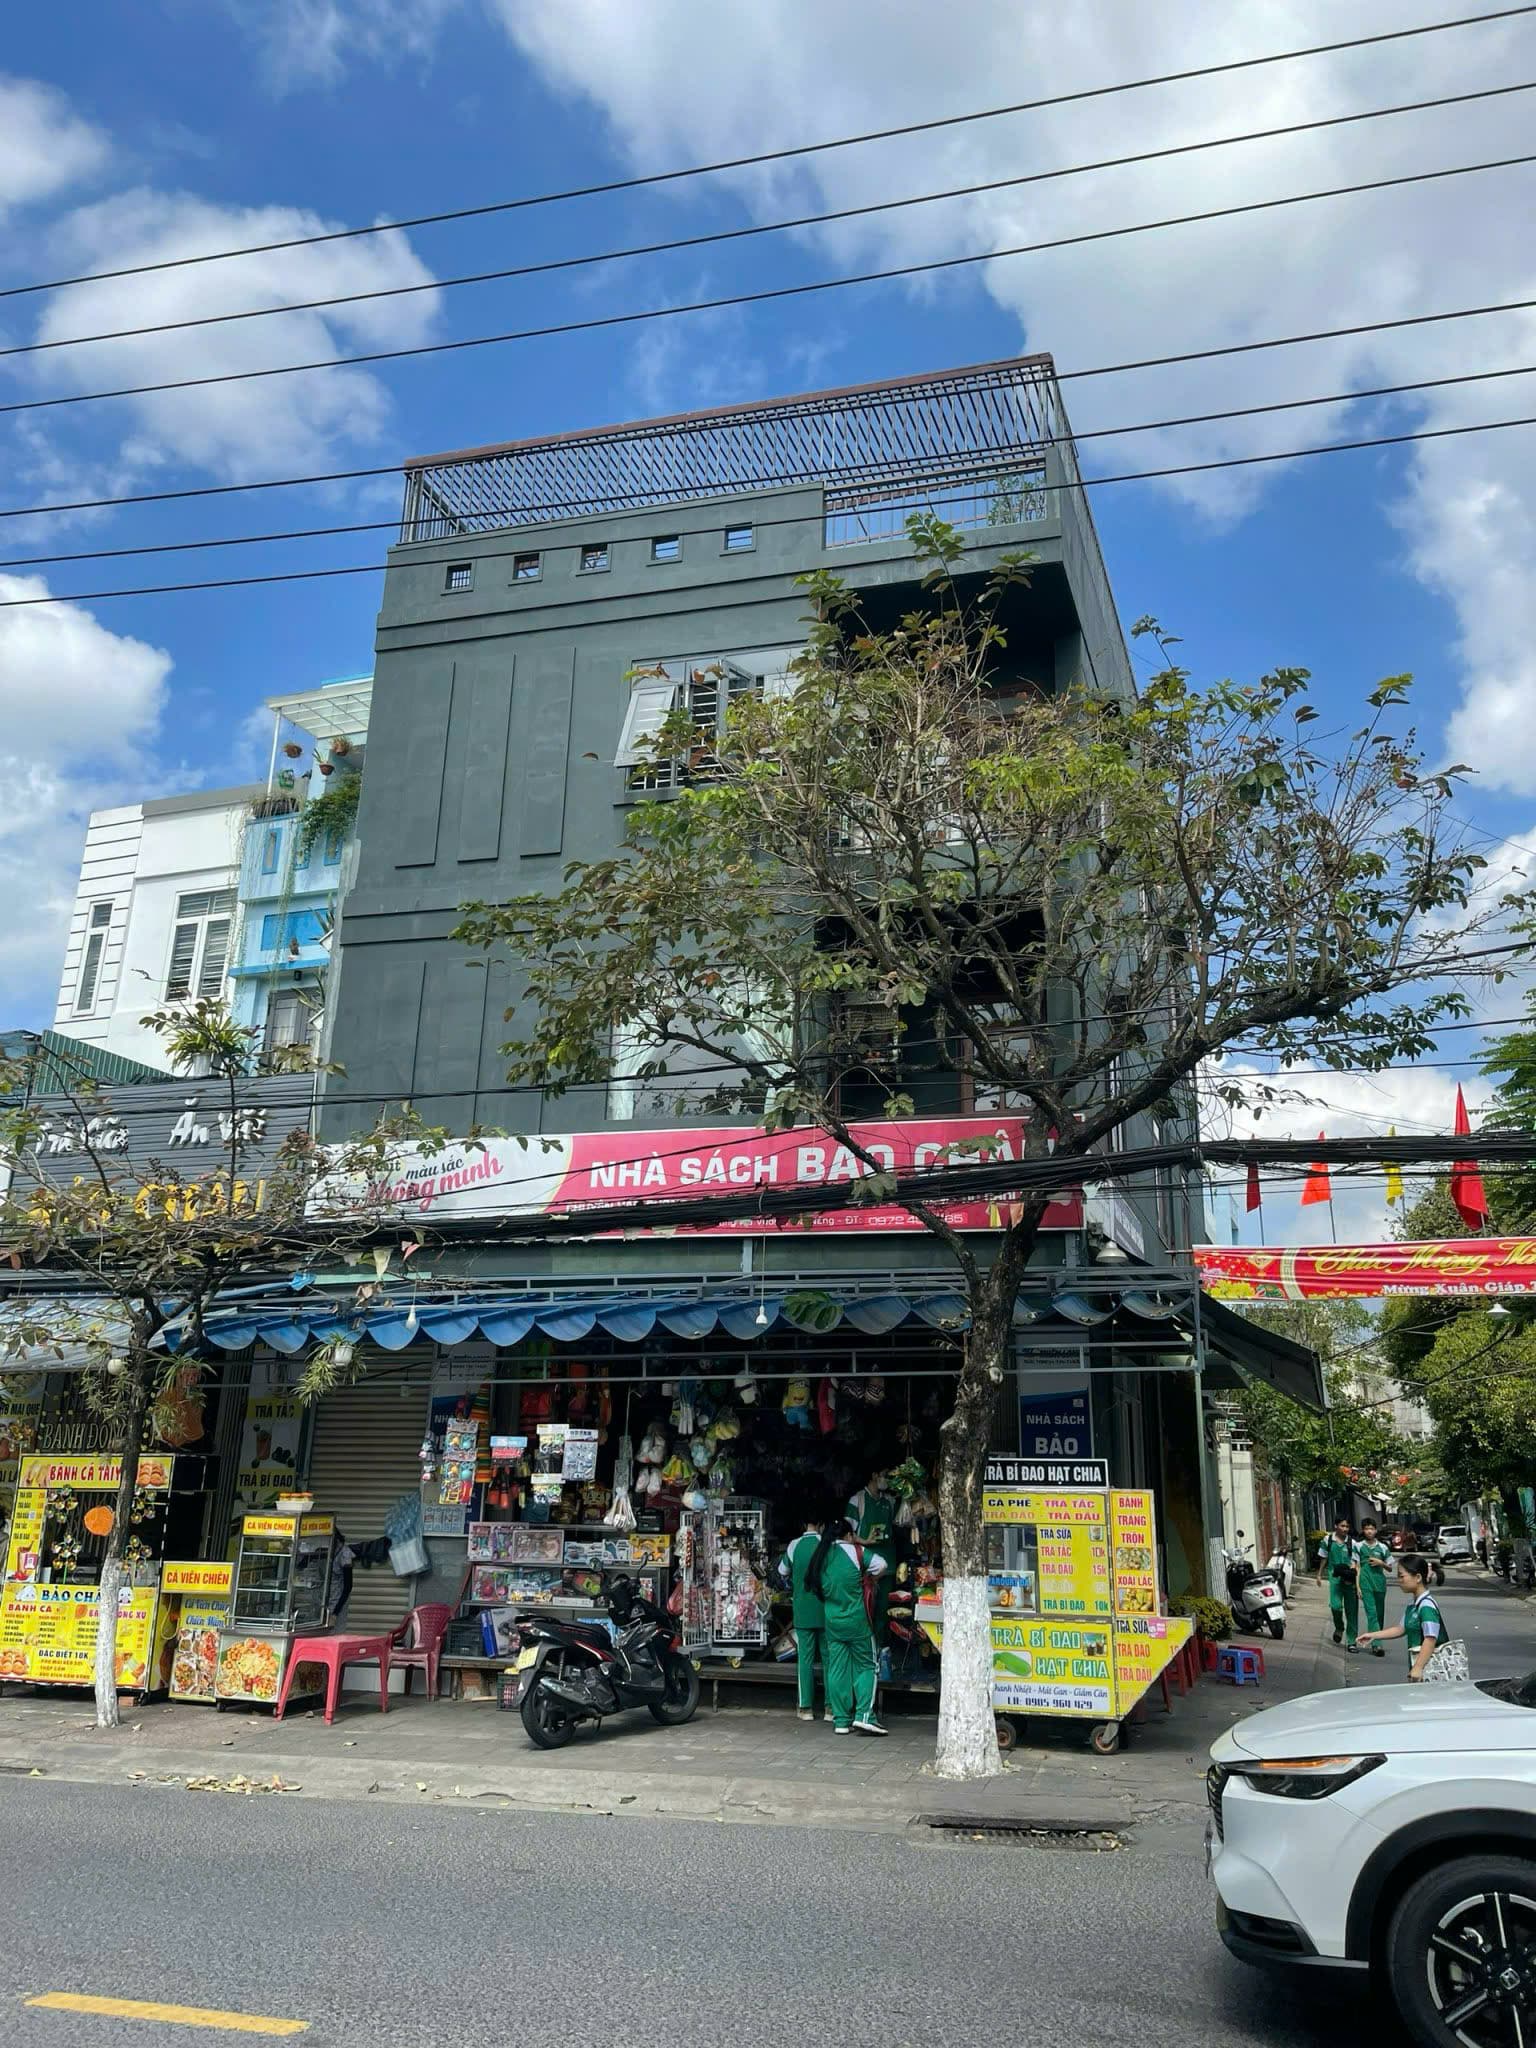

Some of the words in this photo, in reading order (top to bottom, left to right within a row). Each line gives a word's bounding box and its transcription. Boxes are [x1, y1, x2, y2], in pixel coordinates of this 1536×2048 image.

[406, 1163, 439, 1180] màu
[441, 1154, 465, 1173] sắc
[439, 1150, 504, 1195] minh
[590, 1151, 667, 1188] NHÀ
[679, 1149, 779, 1184] SÁCH
[1383, 1284, 1430, 1297] Mừng
[1435, 1282, 1481, 1295] Xuân
[1484, 1281, 1526, 1295] Giáp
[1026, 1412, 1051, 1425] NHÀ
[1054, 1412, 1085, 1425] SÁCH
[1035, 1432, 1079, 1455] BẢO
[50, 1462, 78, 1481] BÁNH
[81, 1462, 94, 1481] CÁ
[239, 1471, 257, 1487] TRÀ
[259, 1471, 270, 1487] BÍ
[1006, 1462, 1018, 1481] BÍ
[1021, 1465, 1045, 1481] ĐAO
[1048, 1466, 1071, 1485] HẠT
[1073, 1466, 1103, 1482] CHIA
[1119, 1496, 1143, 1508] BÁNH
[166, 1570, 178, 1584] CÁ
[181, 1570, 200, 1584] VIÊN
[202, 1571, 230, 1585] CHIÊN
[41, 1585, 71, 1601] BẢO
[991, 1625, 1024, 1647] TRÀ
[1029, 1626, 1046, 1648] BÍ
[1049, 1631, 1082, 1649] ĐAO
[1035, 1657, 1068, 1680] HẠT
[1072, 1658, 1109, 1679] CHIA
[994, 1682, 1012, 1693] hanh
